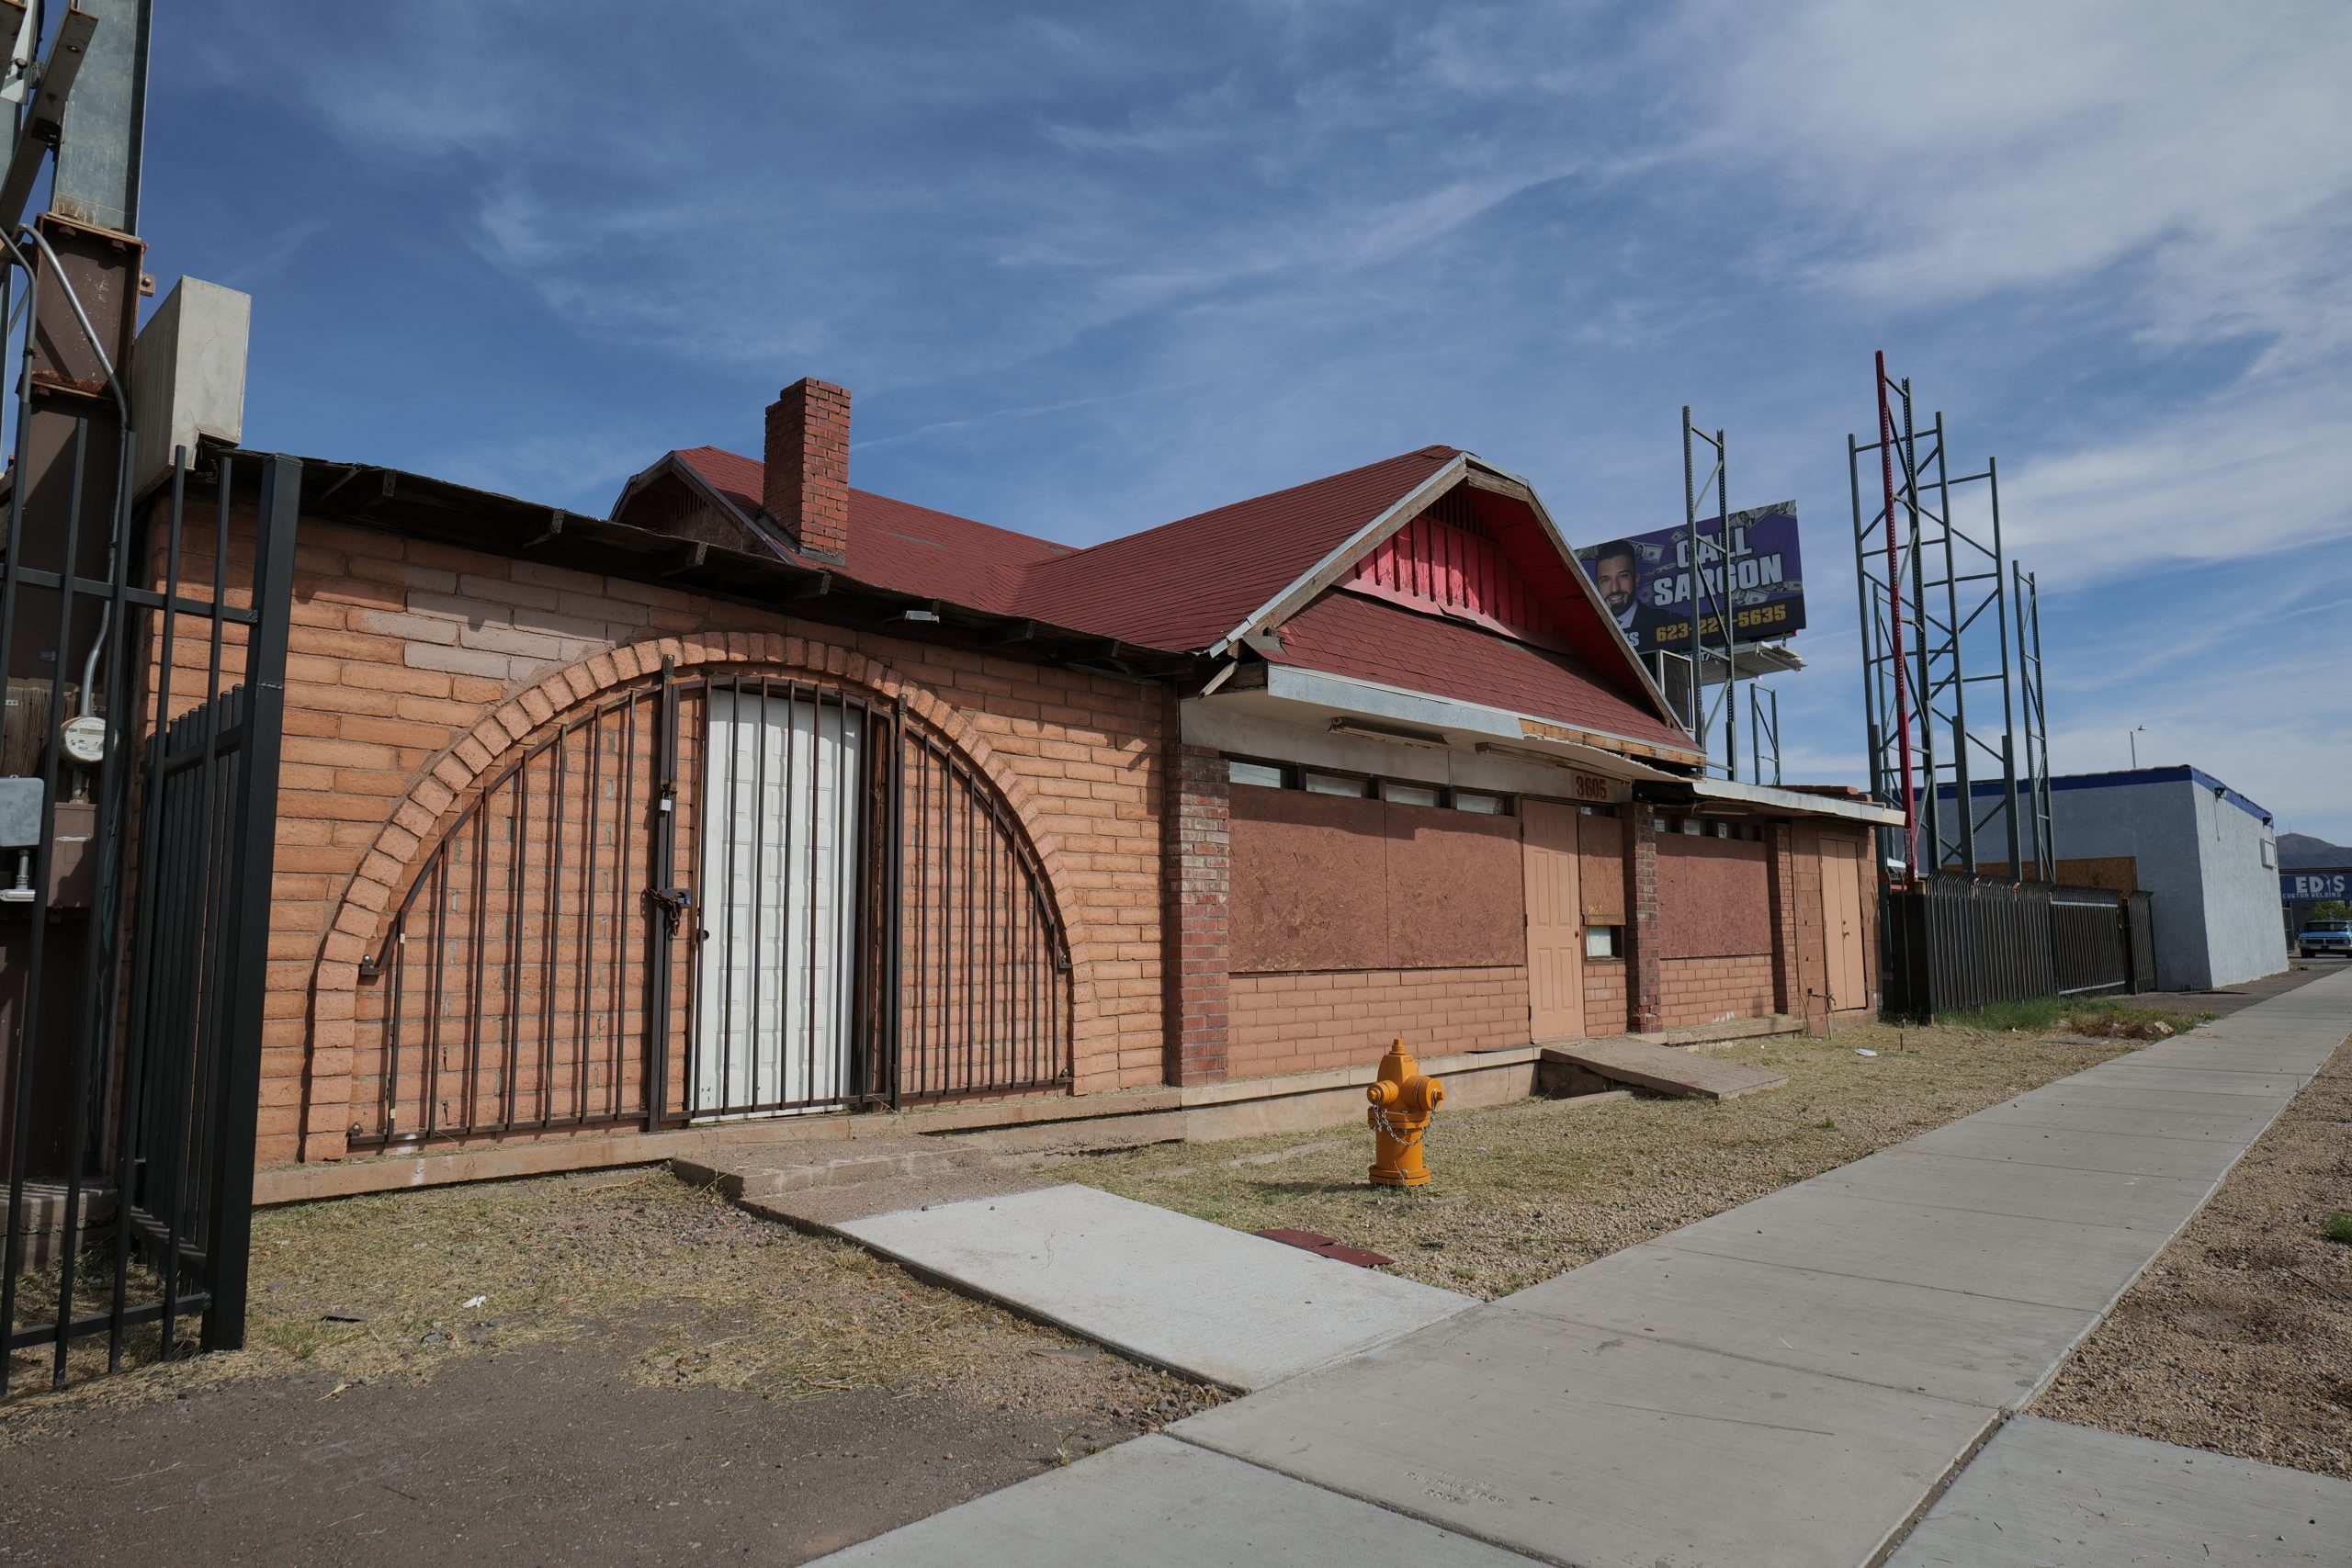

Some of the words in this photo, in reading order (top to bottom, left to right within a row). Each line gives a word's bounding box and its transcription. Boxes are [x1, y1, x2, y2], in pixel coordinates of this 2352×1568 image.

[1677, 527, 1753, 569] CAL
[1654, 554, 1783, 606] SARGON
[1657, 604, 1786, 642] 623-22-5635
[1576, 776, 1607, 799] 3605
